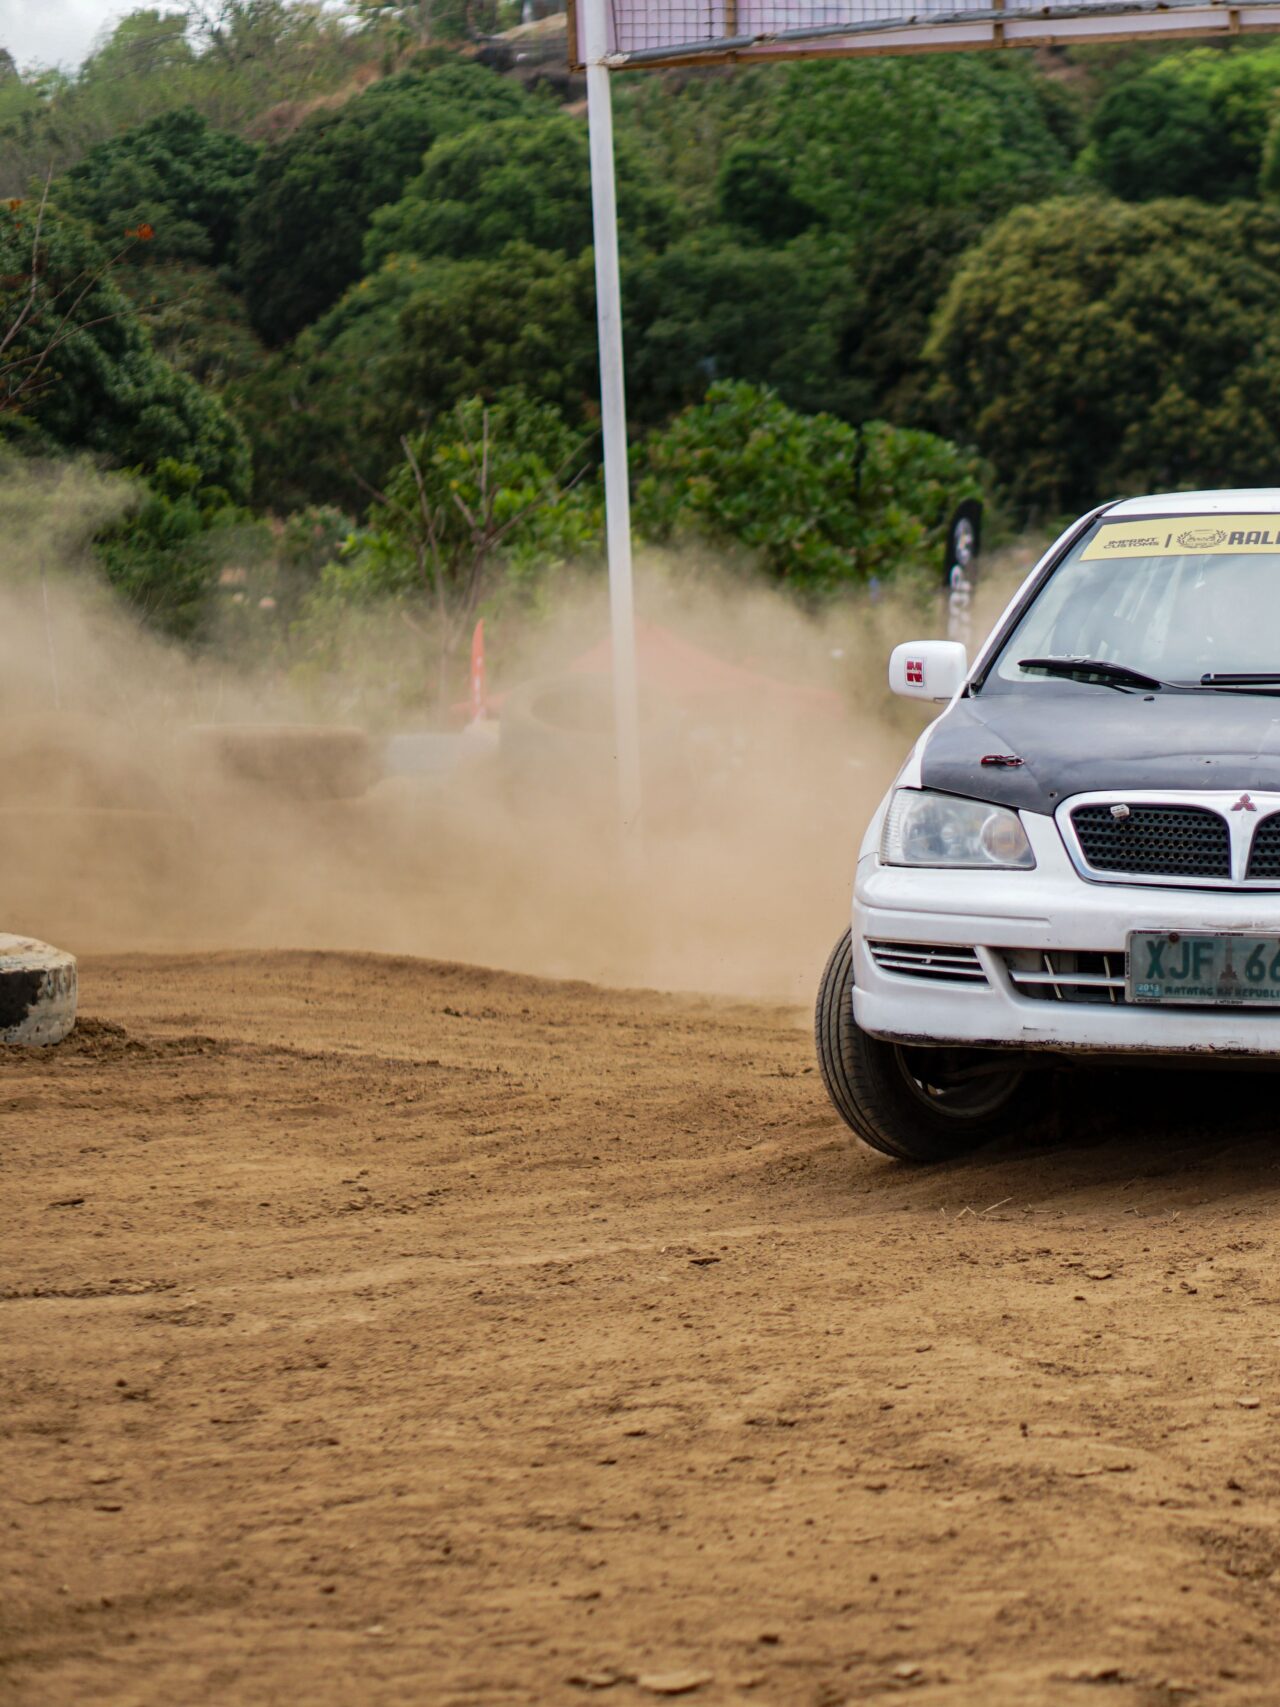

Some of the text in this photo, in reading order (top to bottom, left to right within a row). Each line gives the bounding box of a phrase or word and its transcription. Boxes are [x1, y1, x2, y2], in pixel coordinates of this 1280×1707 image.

[1103, 541, 1159, 549] CUSTOMS
[1108, 537, 1157, 545] IMPRINT
[1145, 940, 1214, 980] XJF
